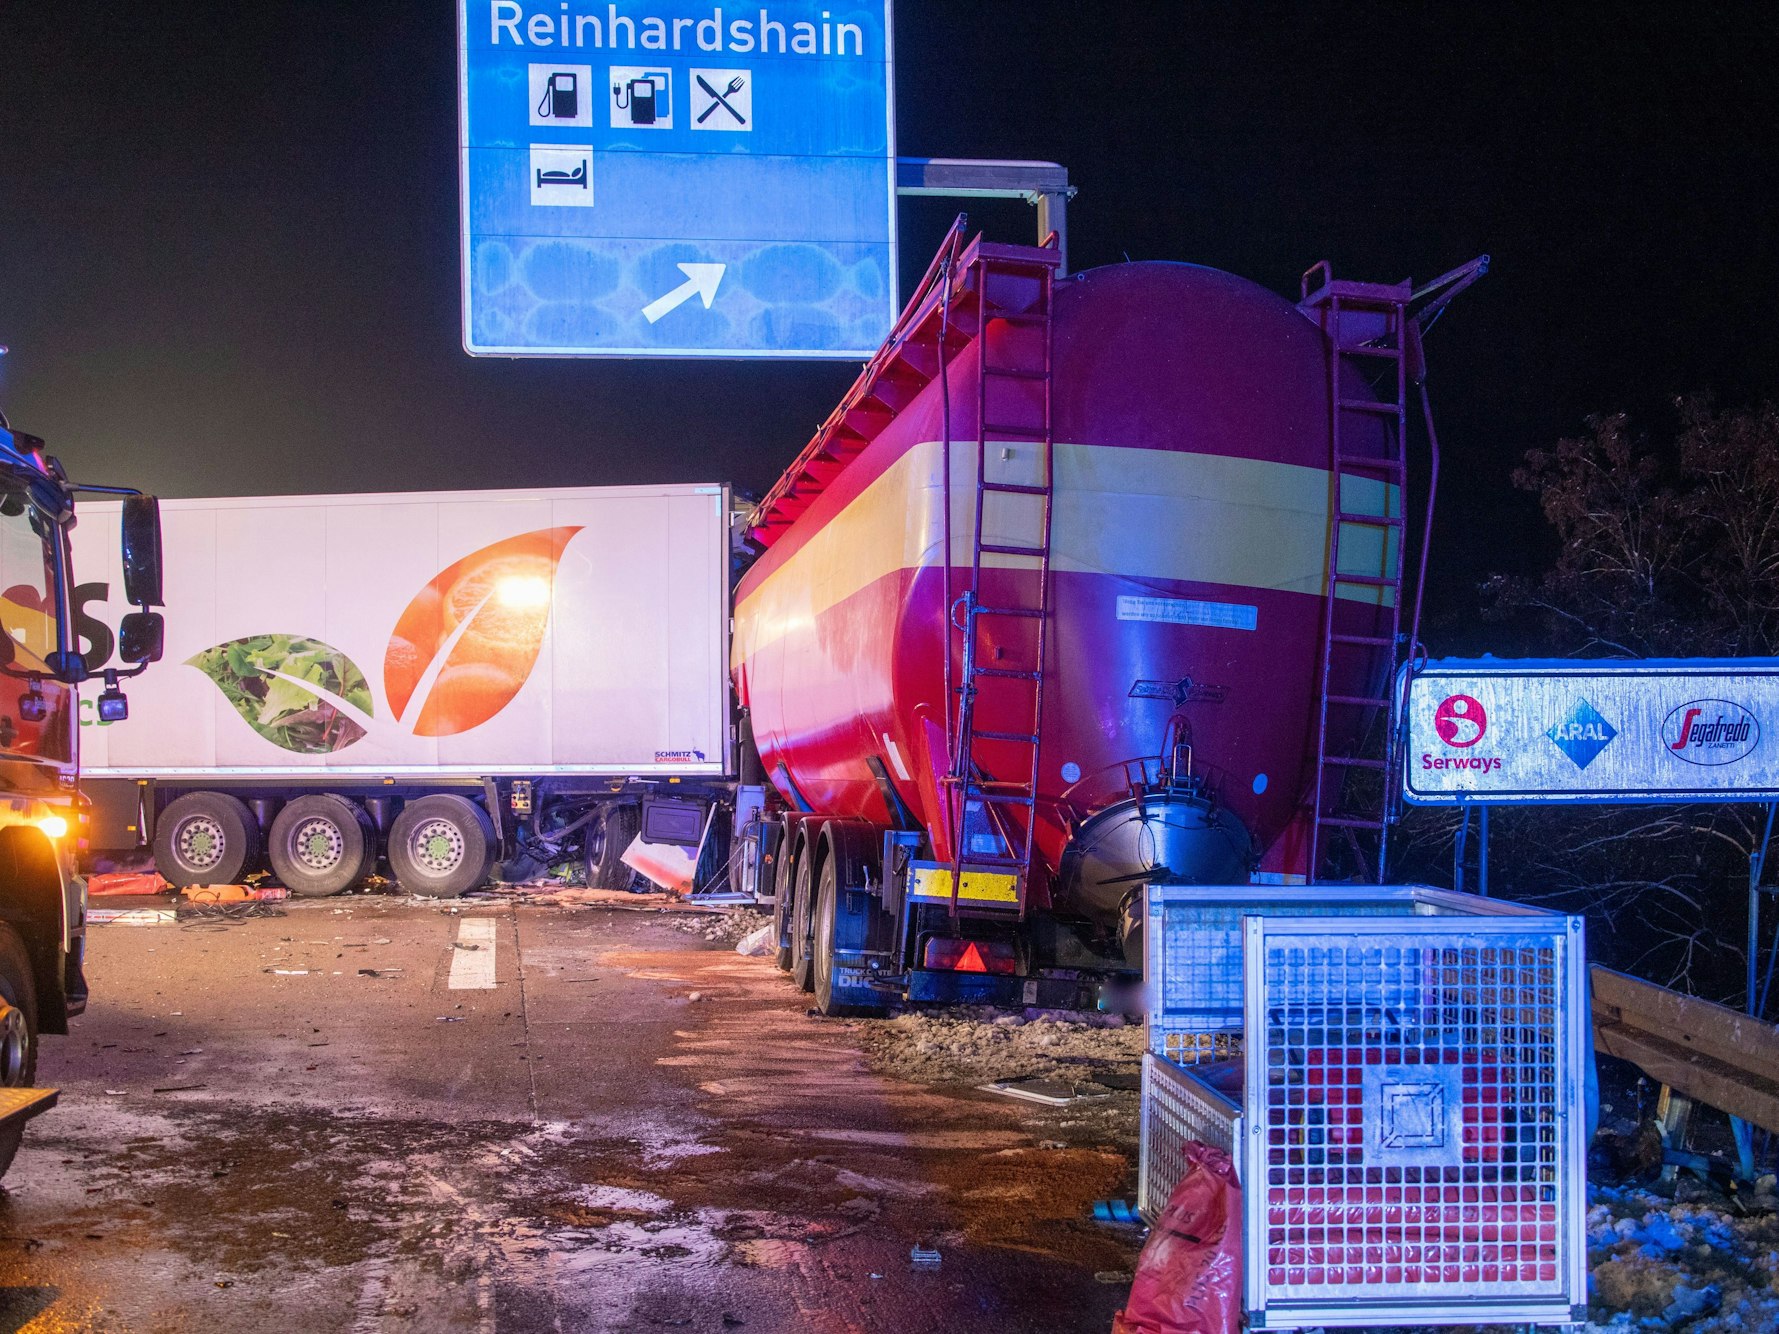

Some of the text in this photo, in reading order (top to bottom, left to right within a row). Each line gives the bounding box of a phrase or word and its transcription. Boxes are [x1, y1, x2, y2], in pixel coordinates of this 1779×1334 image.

[490, 0, 863, 56] Reinhardshain
[1556, 726, 1609, 741] ARAL
[1671, 708, 1751, 750] Segafredo
[1422, 754, 1501, 773] Serways
[840, 967, 866, 975] TRUCK
